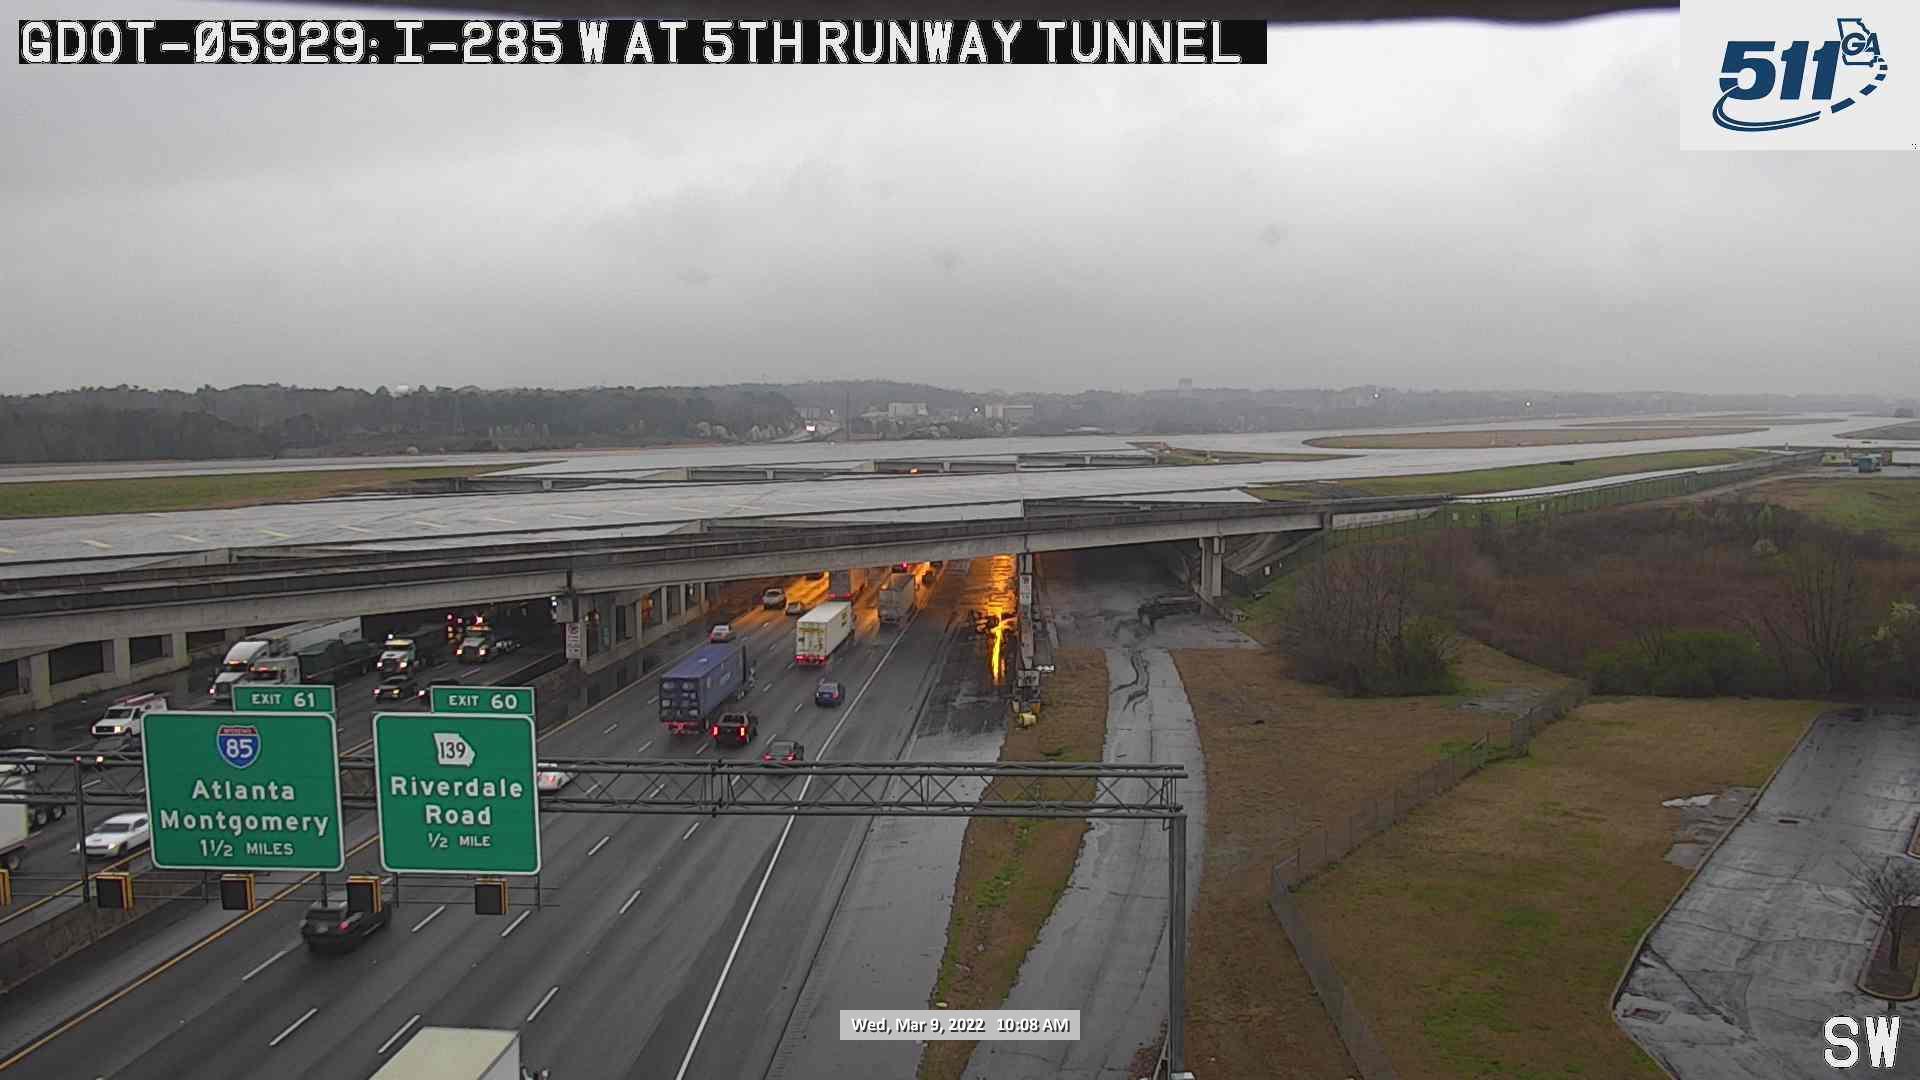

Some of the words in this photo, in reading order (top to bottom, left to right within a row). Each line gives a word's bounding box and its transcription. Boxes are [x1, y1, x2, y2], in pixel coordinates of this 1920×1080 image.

[251, 693, 281, 705] EXIT
[293, 692, 316, 708] 61
[448, 695, 479, 706] EXIT
[491, 694, 518, 710] 60
[226, 738, 253, 758] 85
[439, 741, 466, 759] 139
[192, 779, 295, 801] Atlanta
[391, 775, 523, 798] Riverdale
[160, 809, 329, 836] Montgomery
[425, 804, 491, 825] Road
[246, 842, 293, 856] MILES
[459, 835, 491, 848] MILE
